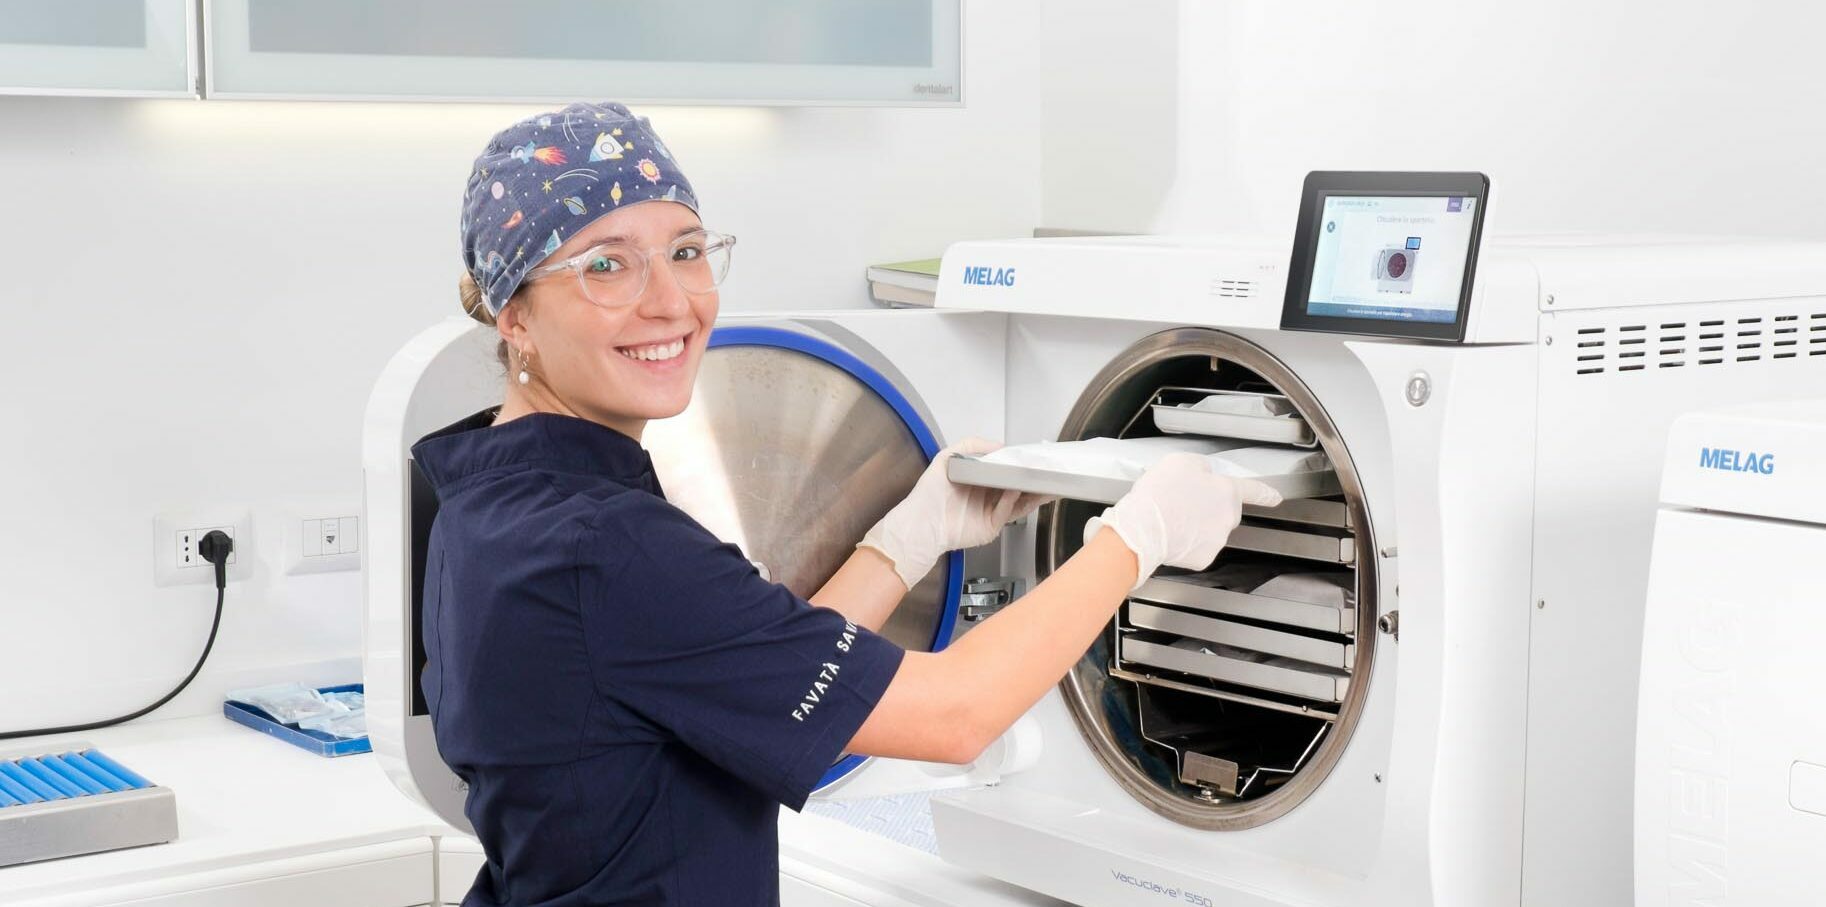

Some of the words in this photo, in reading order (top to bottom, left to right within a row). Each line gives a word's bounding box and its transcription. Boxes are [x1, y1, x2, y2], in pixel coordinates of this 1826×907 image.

[963, 266, 1016, 287] MELAG
[1700, 447, 1775, 475] MELAG
[792, 662, 840, 722] FAVATÀ
[1184, 891, 1212, 907] 550
